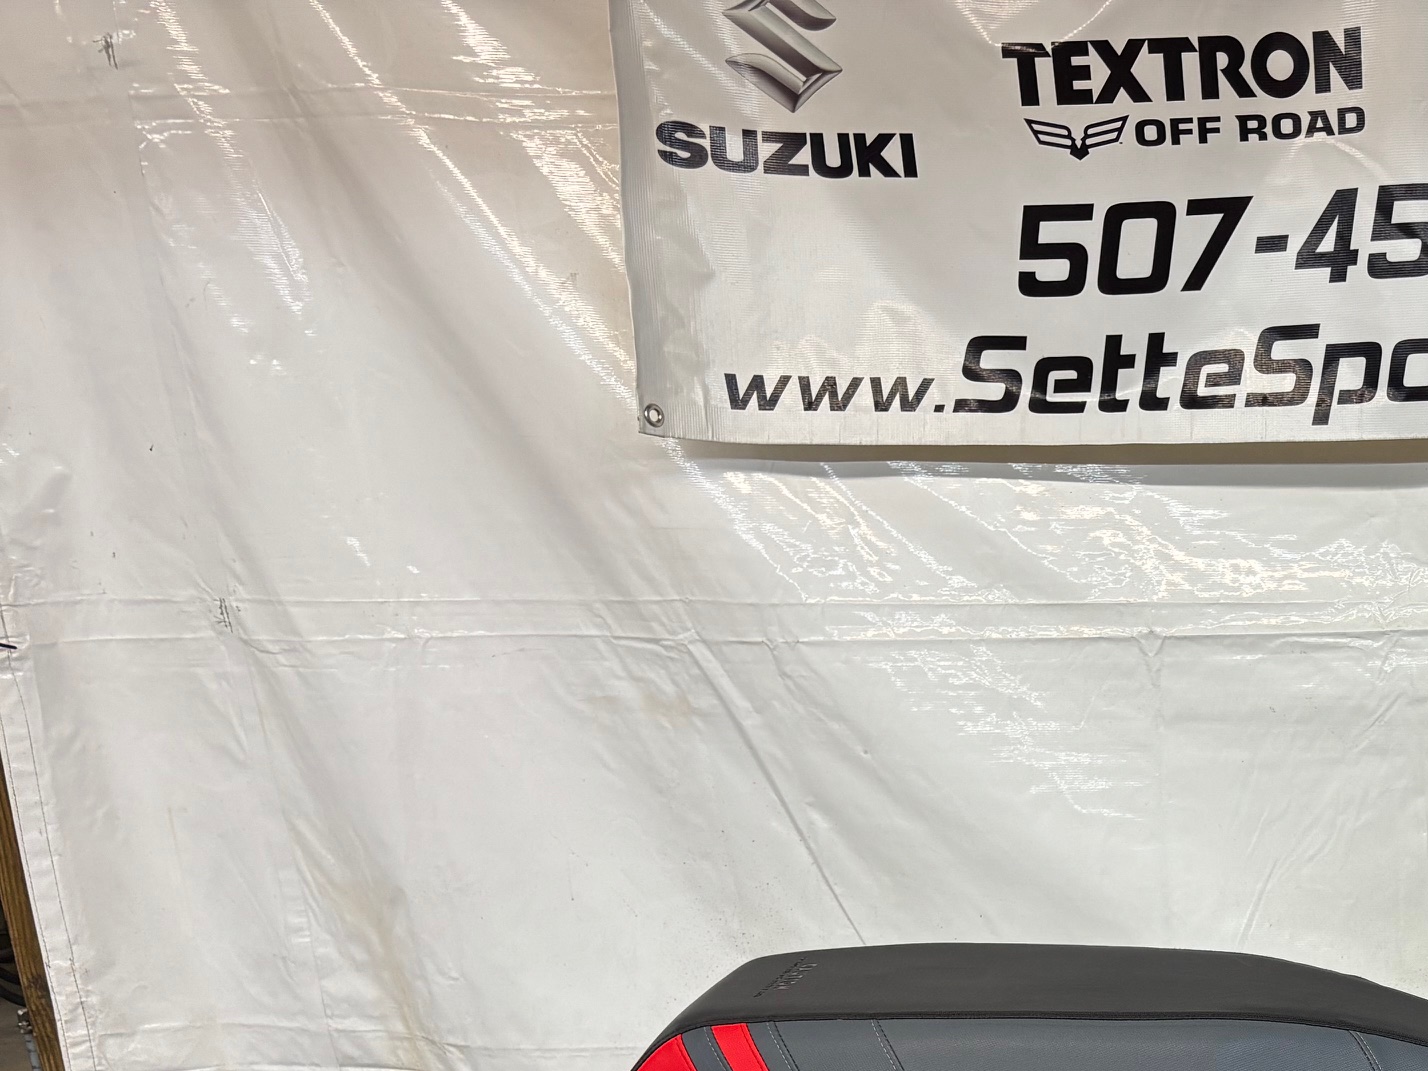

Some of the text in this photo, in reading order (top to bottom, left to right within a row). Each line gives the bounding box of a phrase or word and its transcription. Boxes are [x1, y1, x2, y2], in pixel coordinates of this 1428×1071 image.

[1001, 26, 1364, 107] TEXTRON
[656, 120, 919, 180] SUZUKI
[1134, 107, 1367, 148] OFF ROAD
